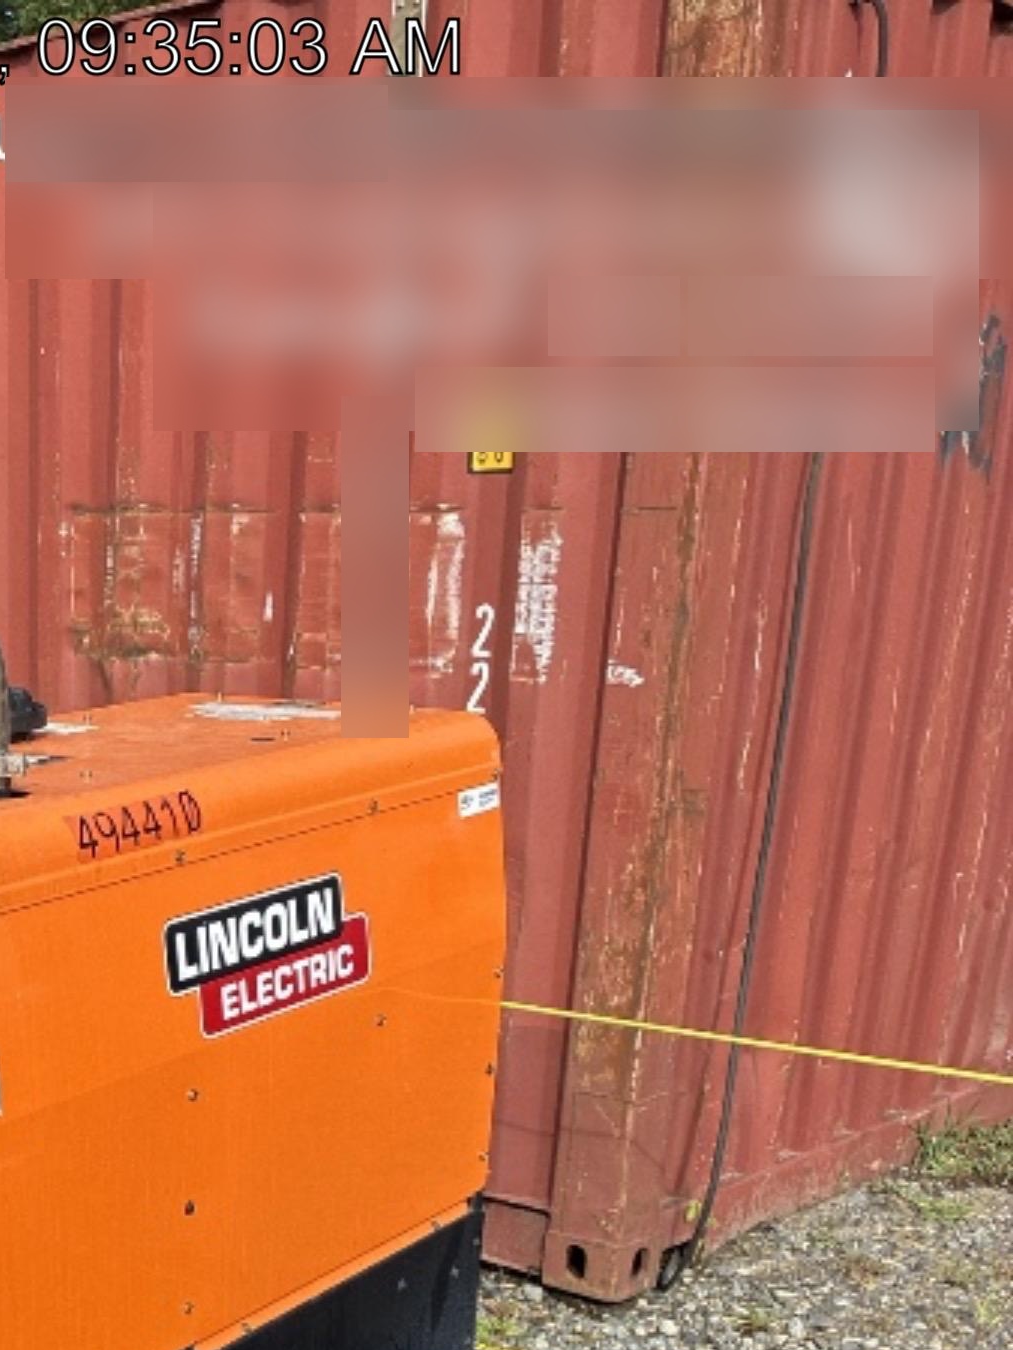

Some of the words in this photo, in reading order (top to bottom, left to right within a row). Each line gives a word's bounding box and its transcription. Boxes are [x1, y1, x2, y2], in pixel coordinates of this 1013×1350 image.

[77, 790, 202, 858] 494410
[173, 887, 335, 981] LINCOLN
[220, 945, 354, 1021] ELECTRIC
